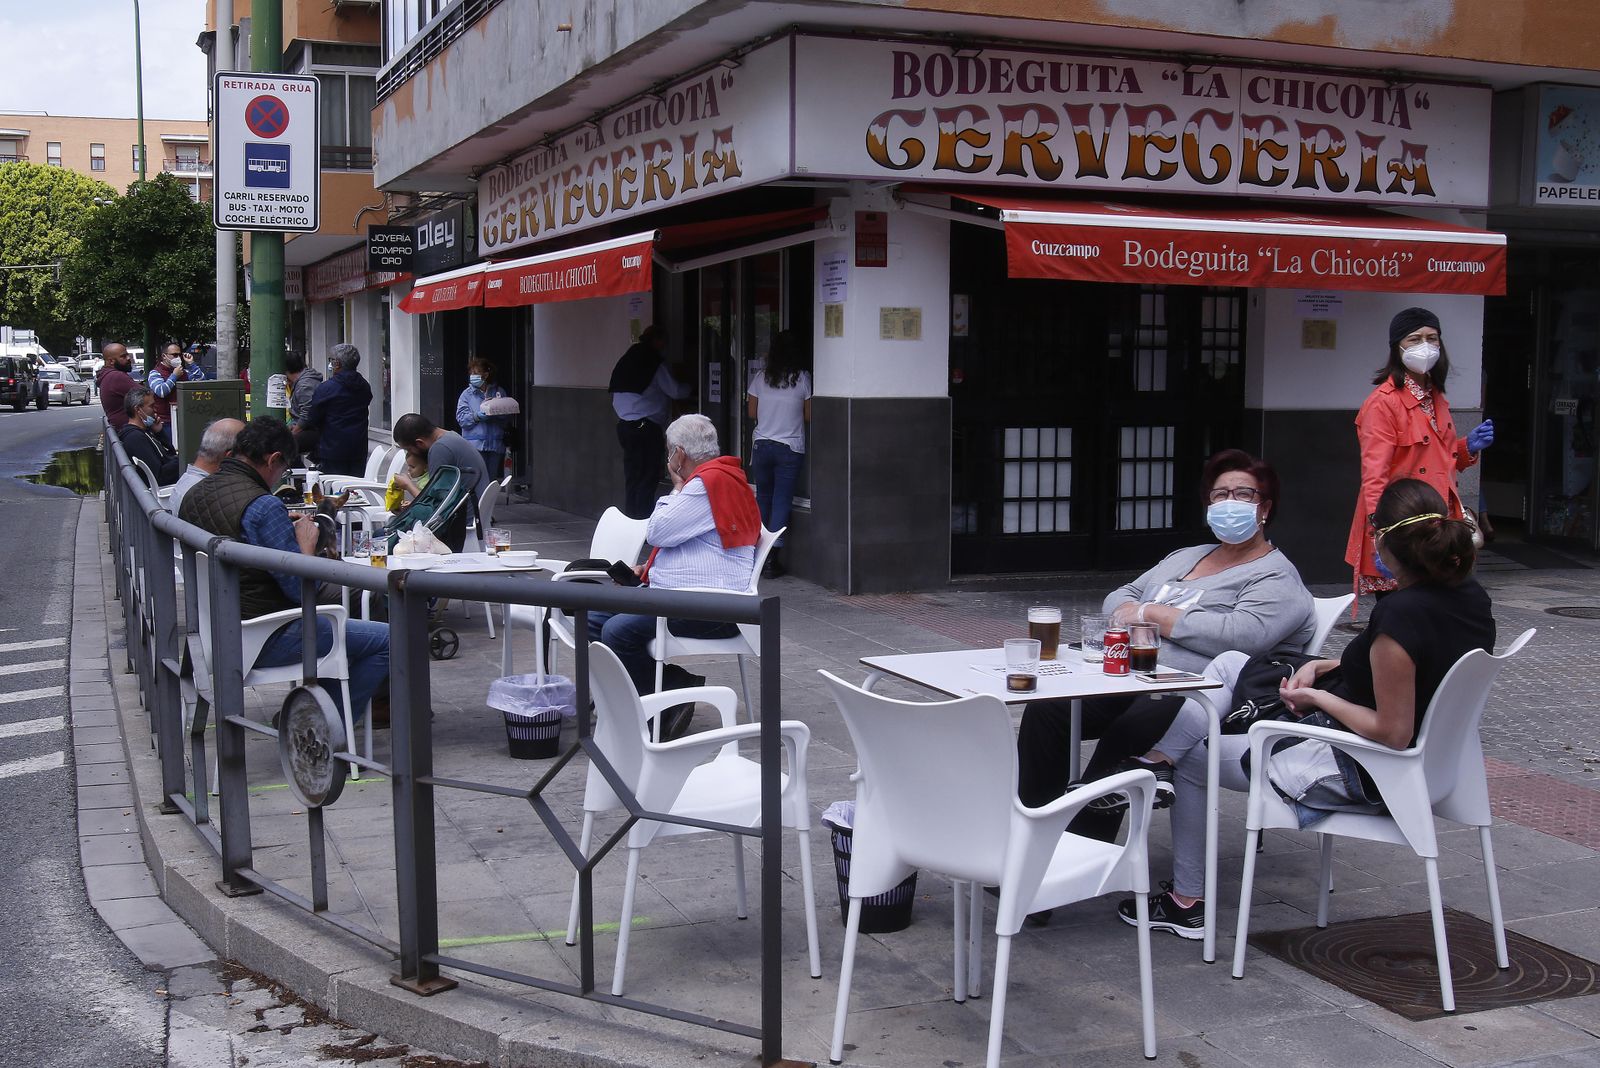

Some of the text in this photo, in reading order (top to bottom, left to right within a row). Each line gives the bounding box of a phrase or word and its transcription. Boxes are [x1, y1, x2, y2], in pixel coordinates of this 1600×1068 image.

[891, 50, 1143, 99] BODEGUITA
[223, 80, 312, 93] RETIRADA GRÚA
[866, 102, 1436, 198] CERVECERIA
[488, 142, 569, 206] BODEGUITA
[483, 125, 743, 248] CERVECERIA
[224, 191, 310, 203] CARRIL RESERVADO
[229, 203, 305, 214] BUS TAXI MOTO
[225, 214, 309, 226] COCHE ELÉCTRICO
[371, 233, 411, 242] JOYERÍA
[371, 246, 413, 255] COMPRO
[381, 257, 402, 265] ORO
[1031, 239, 1100, 259] Cruzcampo
[1122, 239, 1250, 277] Bodeguita
[1427, 257, 1486, 275] Cruzcampo
[519, 272, 554, 294] BODEGUITA
[555, 270, 564, 290] LA
[565, 258, 598, 289] CHICOTÁ
